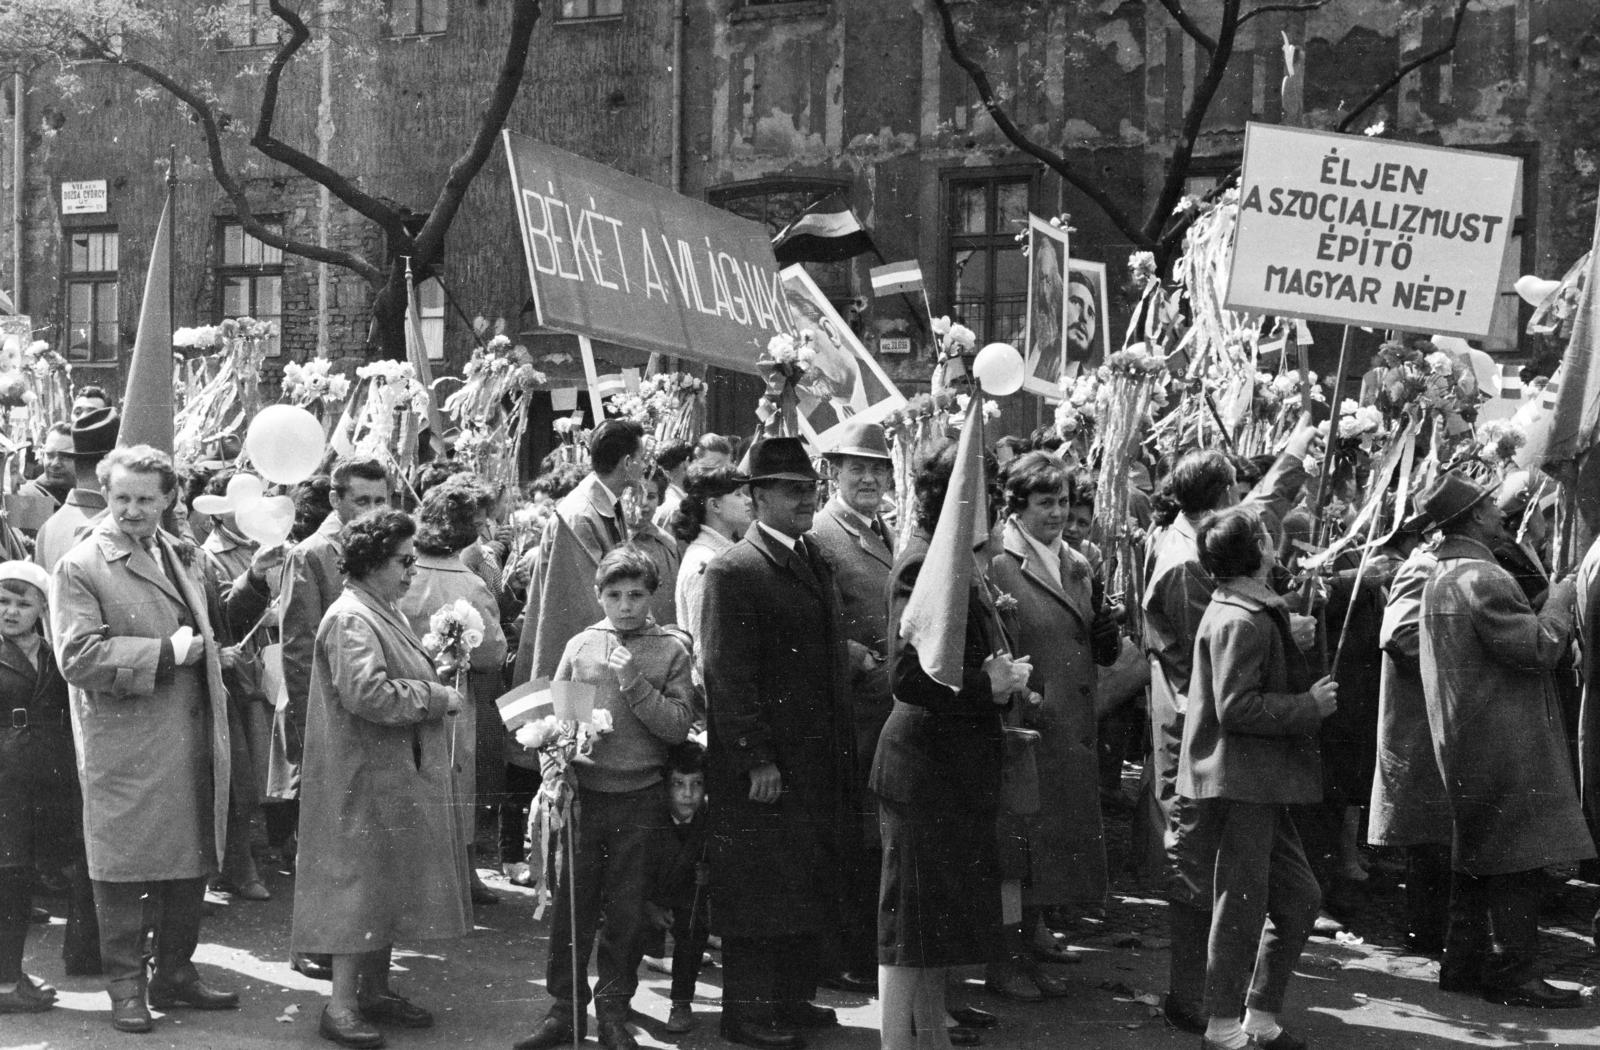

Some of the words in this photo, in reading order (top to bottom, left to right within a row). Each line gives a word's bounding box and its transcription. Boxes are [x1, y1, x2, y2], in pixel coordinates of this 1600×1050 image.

[1320, 147, 1428, 195] ÉLJEN
[1241, 185, 1263, 213] A
[1268, 188, 1503, 243] SZOCIALIZMUST
[522, 181, 630, 293] BÉKÉT
[641, 228, 668, 304] A
[1264, 264, 1381, 305] MAGYAR
[1392, 274, 1467, 316] NÉP!
